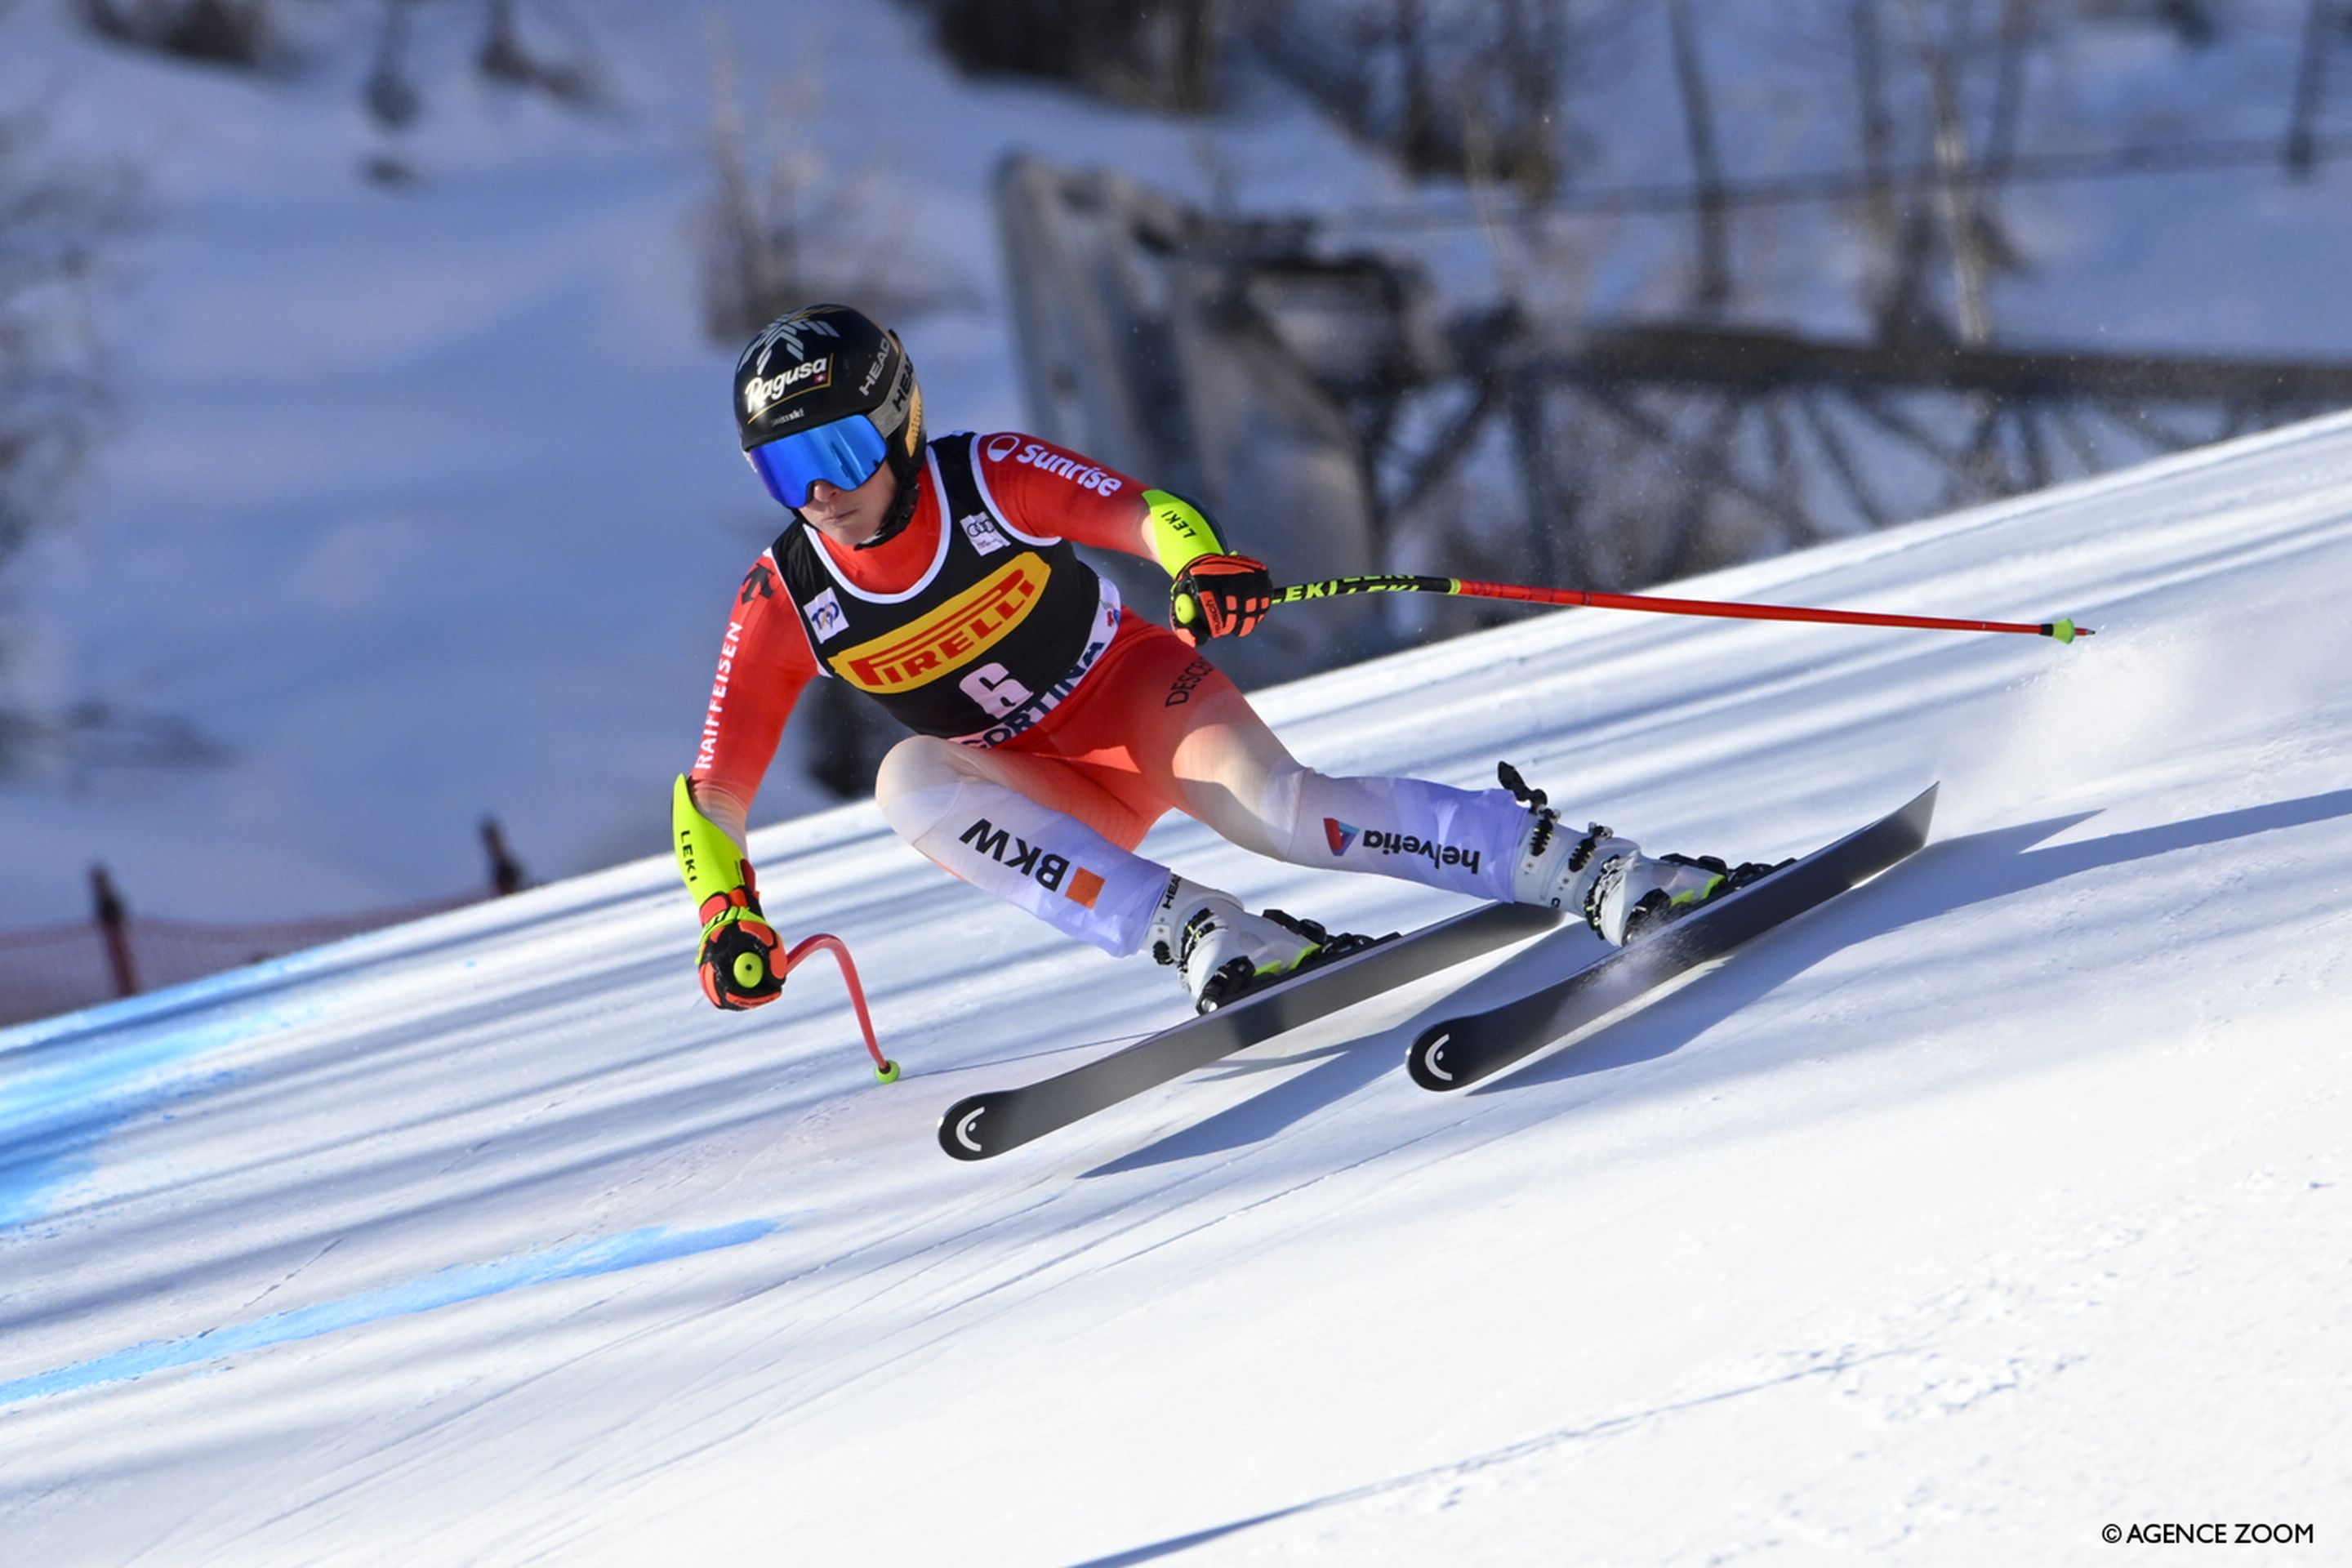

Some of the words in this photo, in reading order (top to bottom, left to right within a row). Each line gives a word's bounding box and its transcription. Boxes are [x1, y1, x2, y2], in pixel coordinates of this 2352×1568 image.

[744, 357, 827, 413] Ragusa
[858, 337, 892, 397] HEAD
[1017, 443, 1122, 497] Sunrise
[1161, 510, 1197, 539] LEKI
[848, 569, 1036, 686] PIRELLI
[694, 621, 743, 769] RAIFFEISEN
[958, 662, 1035, 720] 6
[681, 831, 697, 883] LEKI
[959, 818, 1070, 892] BKW
[1362, 829, 1481, 875] helvetia
